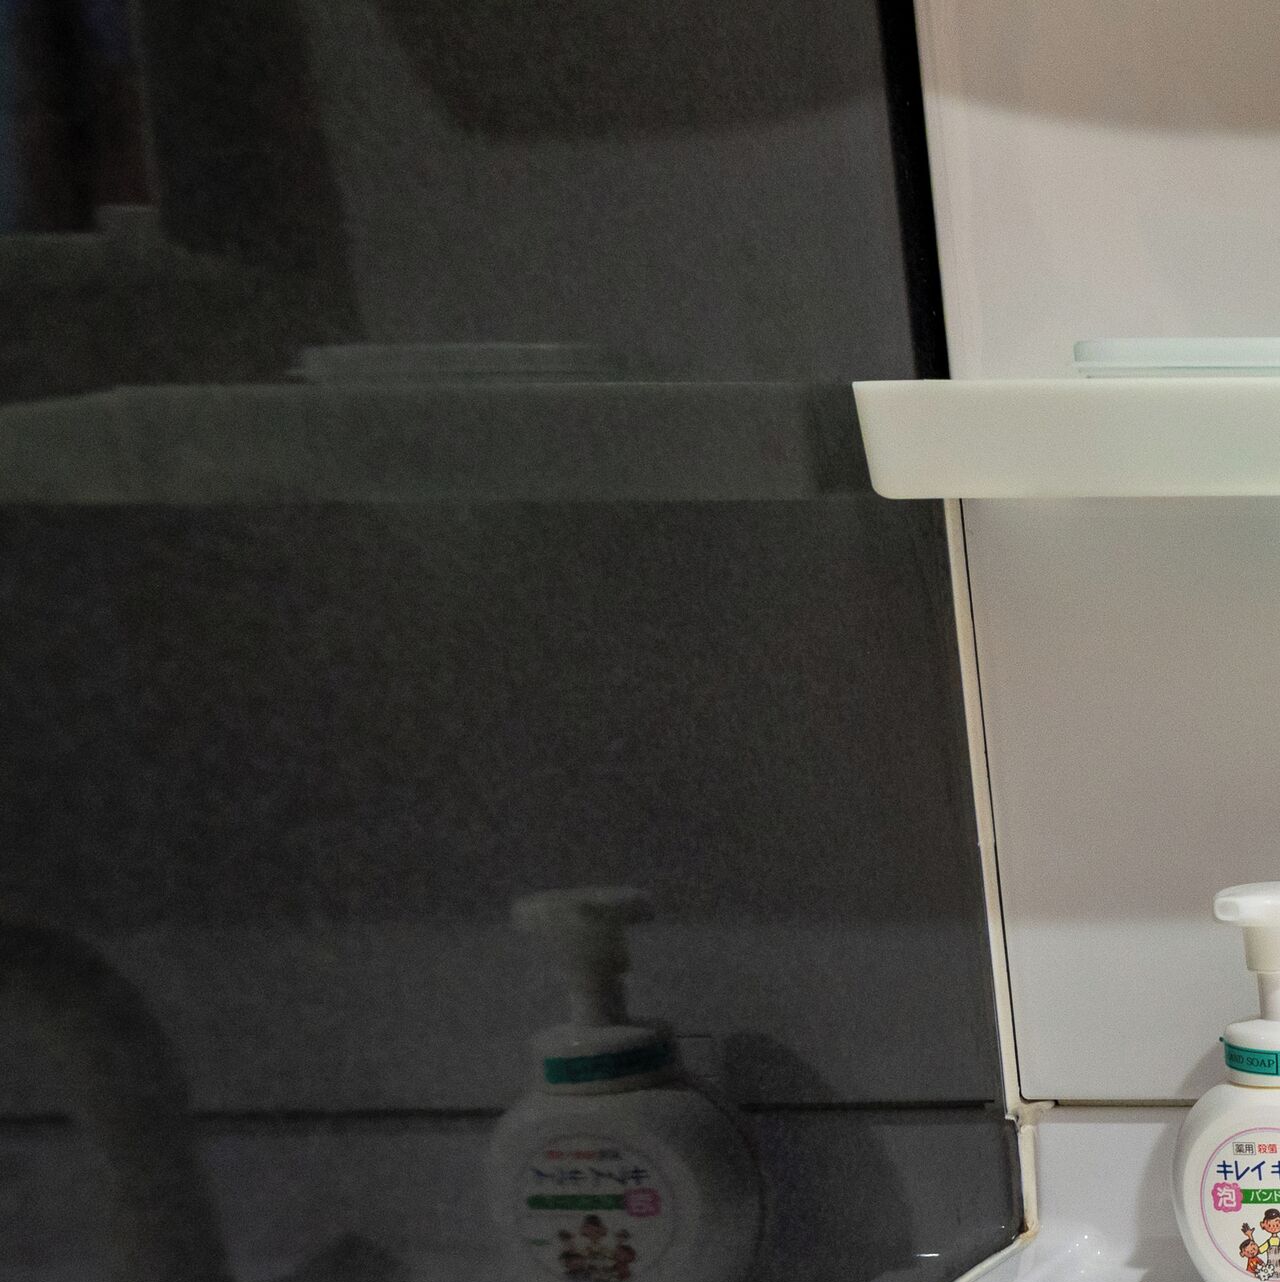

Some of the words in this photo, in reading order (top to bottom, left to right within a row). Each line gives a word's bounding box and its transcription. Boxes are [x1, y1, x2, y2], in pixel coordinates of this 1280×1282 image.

[1246, 1056, 1275, 1068] SOAP
[1234, 1143, 1255, 1154] 薬用
[1216, 1160, 1266, 1181] キレイ
[1217, 1188, 1236, 1207] 泡
